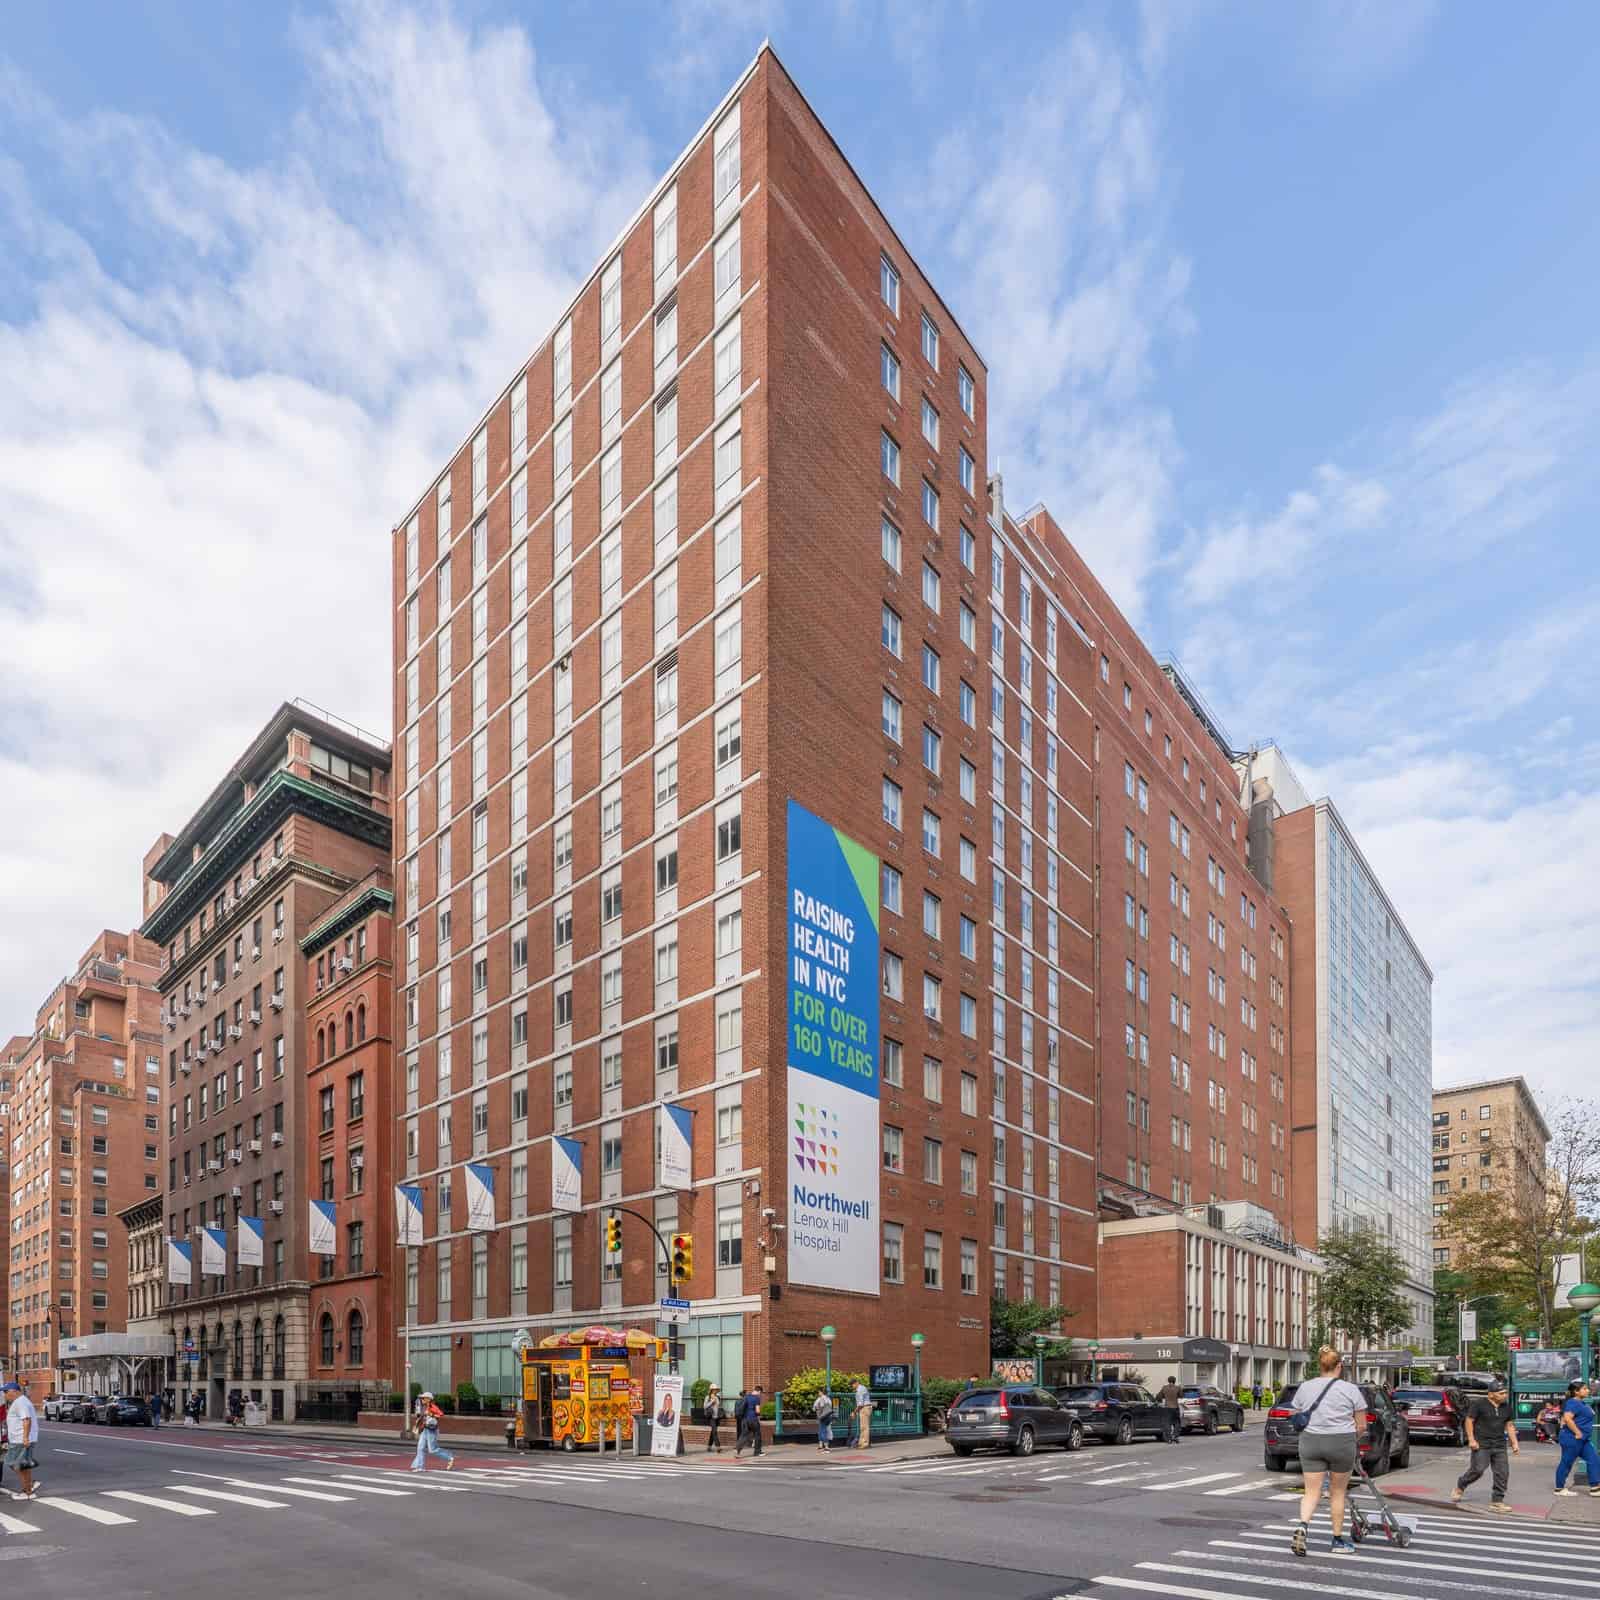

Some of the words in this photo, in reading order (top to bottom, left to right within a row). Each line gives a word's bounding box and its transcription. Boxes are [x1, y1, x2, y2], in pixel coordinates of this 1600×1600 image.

[794, 888, 855, 943] RAISING
[794, 922, 849, 974] HEALTH
[794, 955, 810, 988] IN
[816, 966, 846, 1003] NYC
[794, 990, 825, 1027] FOR
[831, 1006, 868, 1045] OVER
[794, 1023, 822, 1057] 160
[827, 1036, 873, 1079] YEARS
[794, 1183, 869, 1220] Northwell
[794, 1207, 830, 1231] Lenox
[832, 1216, 849, 1234] Hill
[793, 1230, 841, 1253] Hospital
